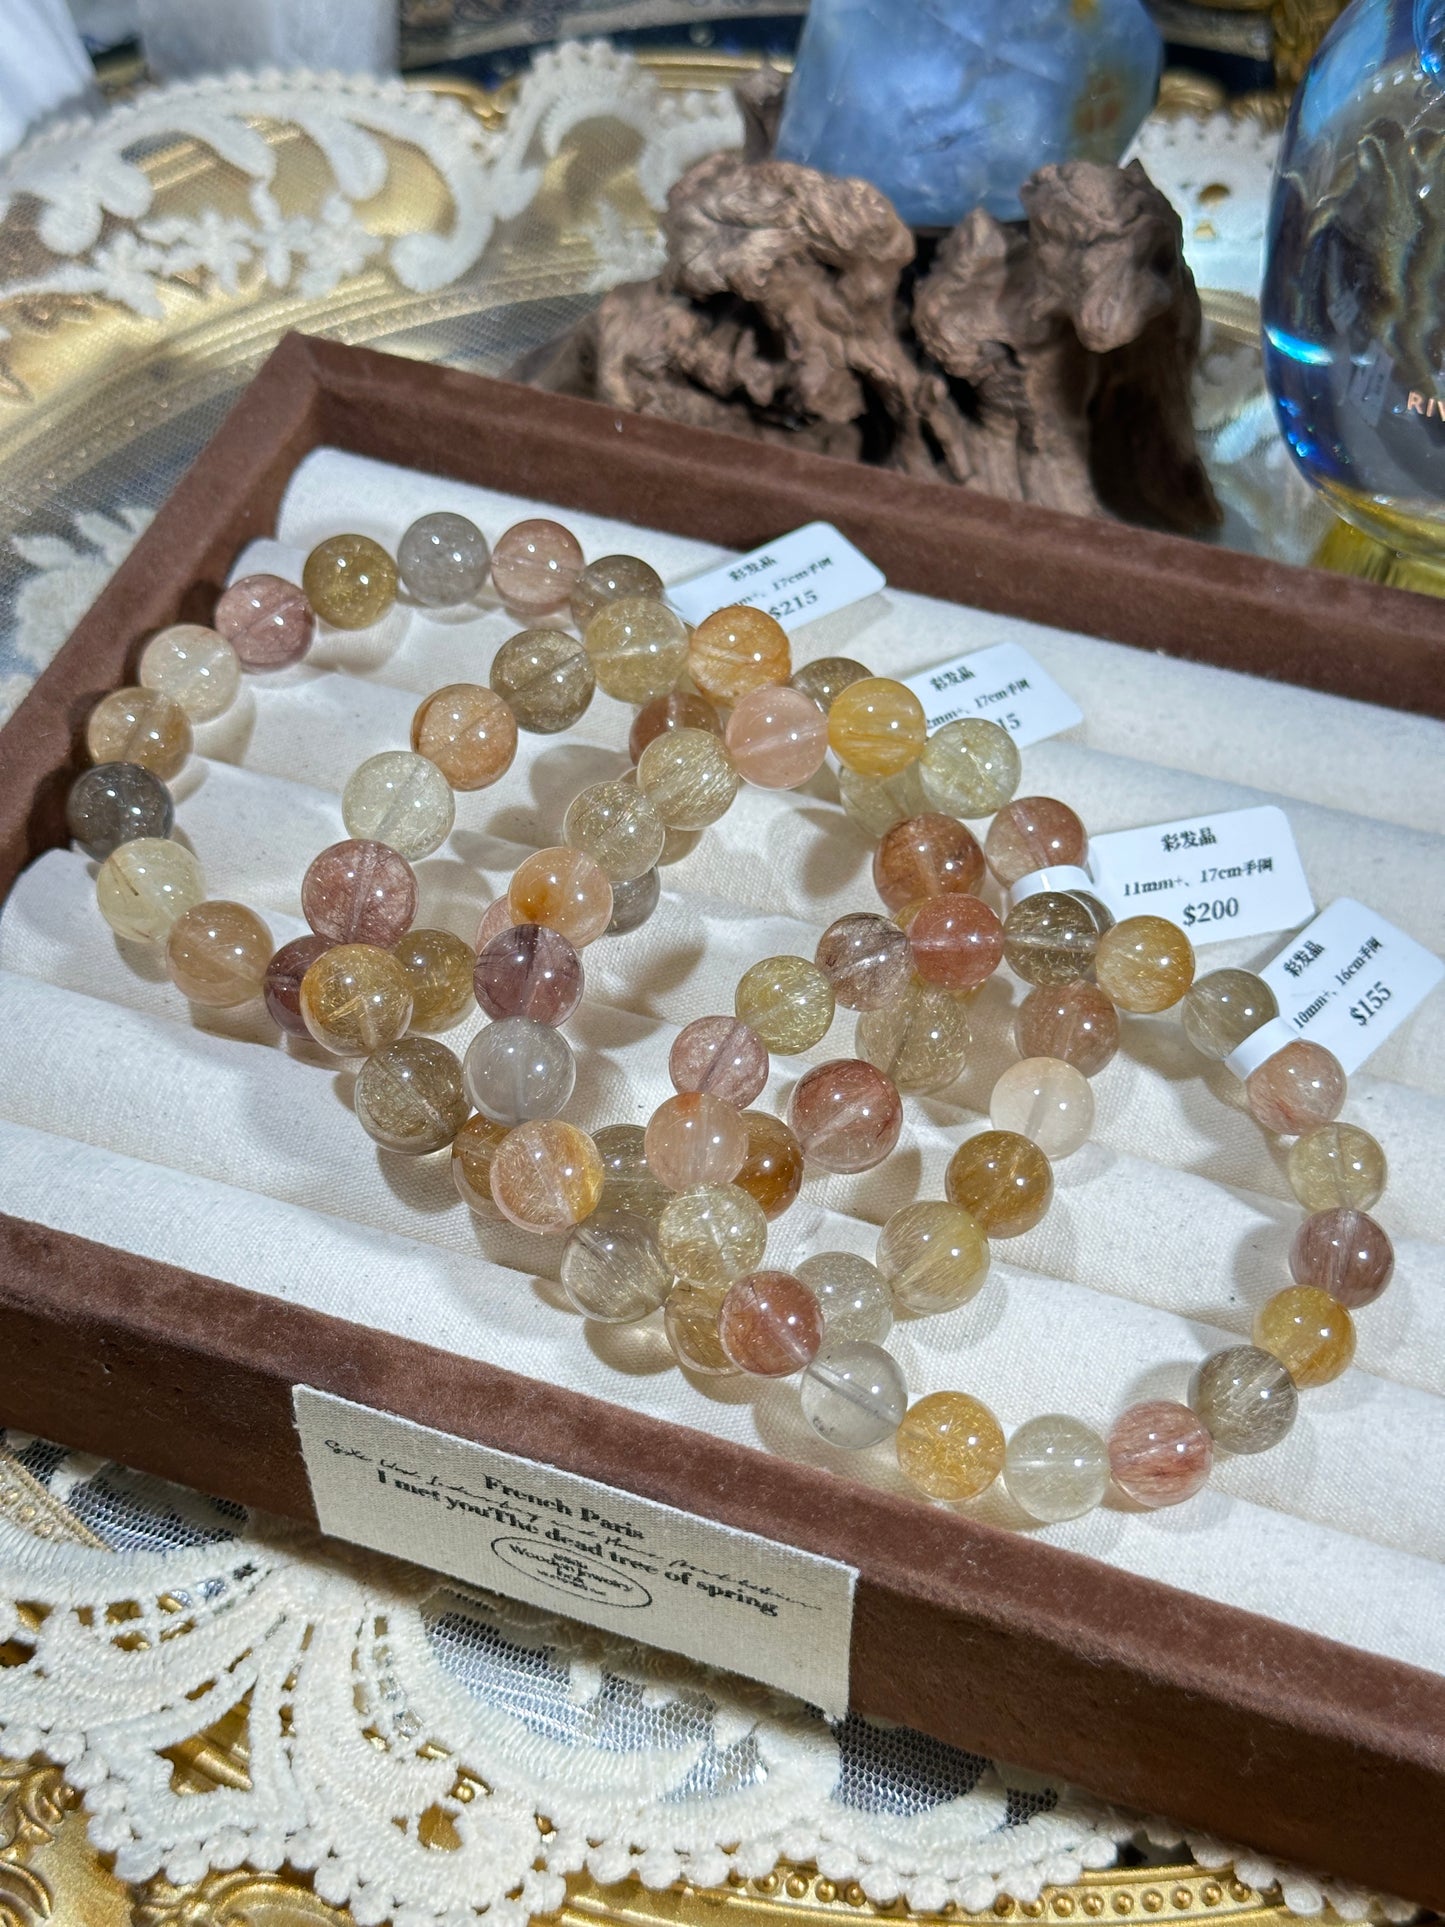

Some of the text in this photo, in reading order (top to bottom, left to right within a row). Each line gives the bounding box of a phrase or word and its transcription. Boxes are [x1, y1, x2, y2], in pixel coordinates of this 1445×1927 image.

[769, 589, 818, 620] $215
[996, 712, 1022, 733] 15
[1161, 827, 1218, 852] 彩发晶
[1182, 897, 1239, 927] $200
[1283, 940, 1325, 979] 彩发晶
[1349, 981, 1393, 1028] $155
[481, 1472, 572, 1516] French
[580, 1507, 645, 1539] Paris
[376, 1469, 387, 1484] I
[393, 1479, 440, 1501] met
[545, 1527, 603, 1558] dead
[610, 1551, 658, 1575] tree
[664, 1570, 693, 1586] of
[696, 1581, 778, 1617] spring
